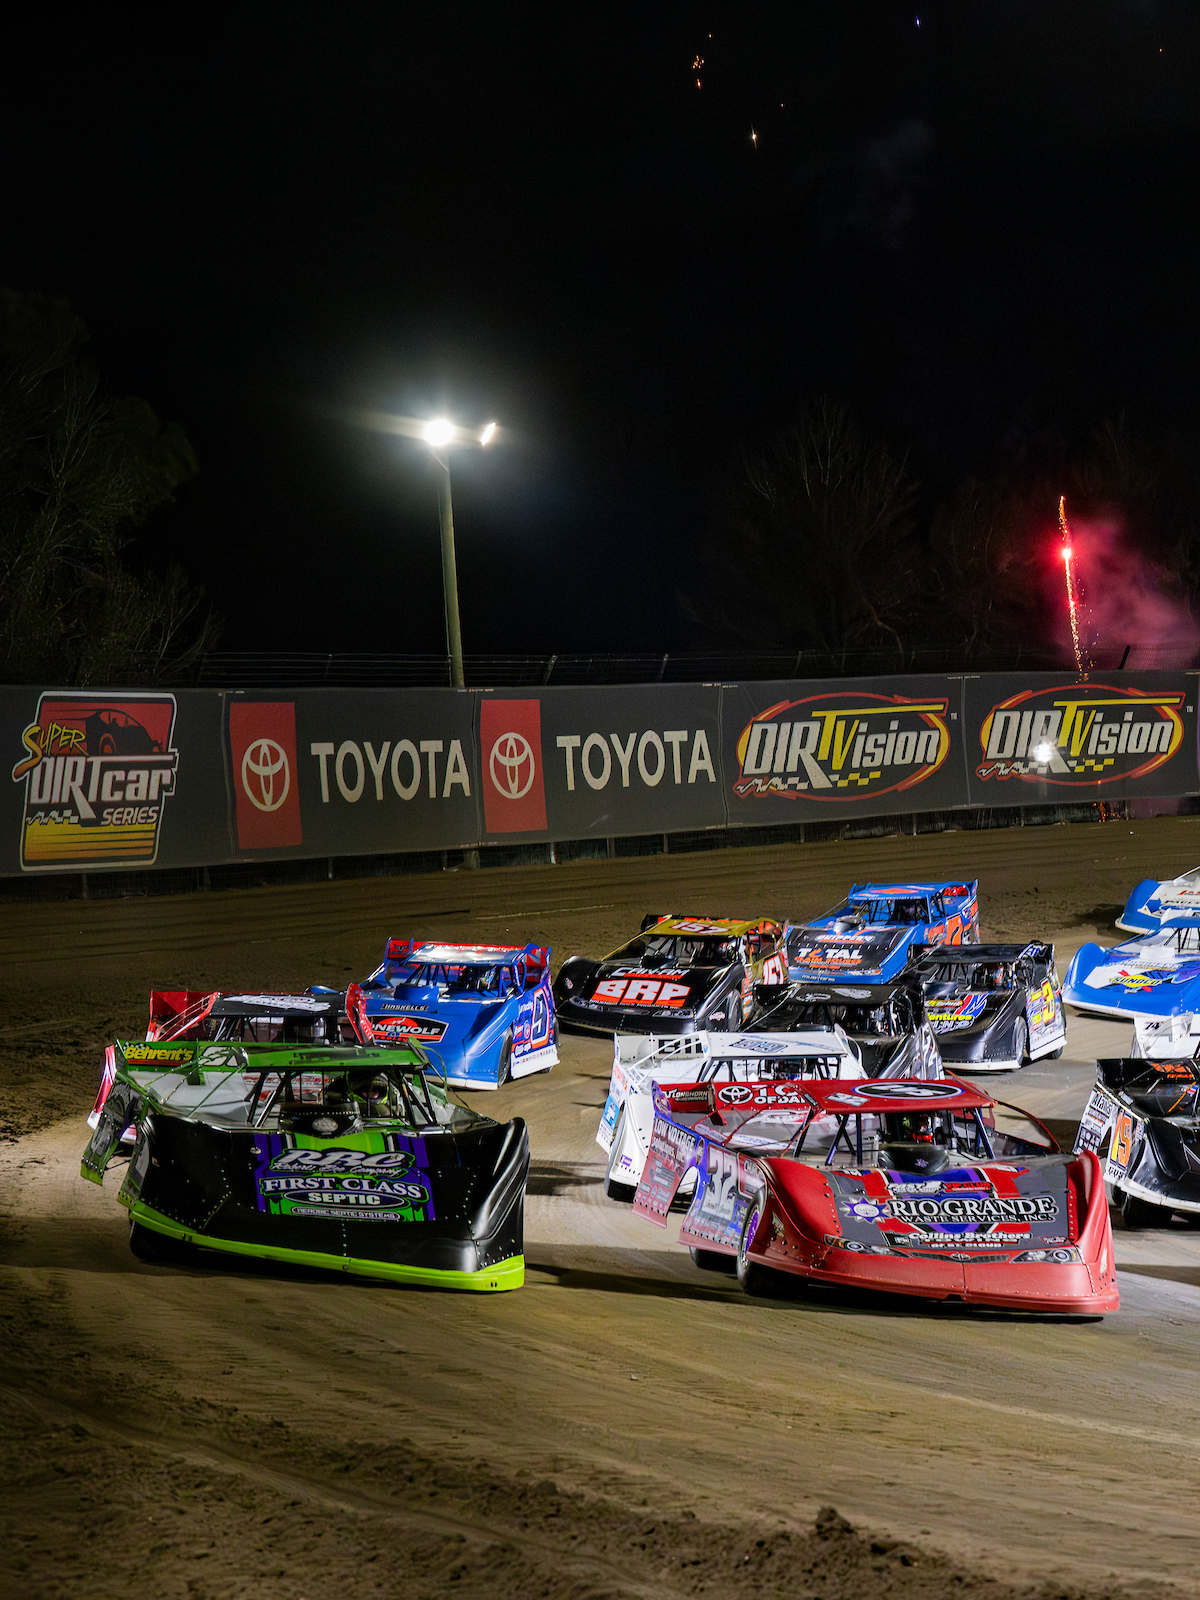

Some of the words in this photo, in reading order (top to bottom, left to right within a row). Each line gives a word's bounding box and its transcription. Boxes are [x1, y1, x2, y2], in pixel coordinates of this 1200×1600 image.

[14, 722, 90, 779] SUPER
[556, 730, 717, 791] TOYOTA
[311, 739, 471, 803] TOYOTA
[101, 806, 159, 826] SERIES
[372, 1024, 441, 1035] NEWOLF
[125, 1046, 195, 1061] Behrent's
[668, 1123, 697, 1150] VOLTAGE
[264, 1177, 336, 1191] FIRST
[341, 1178, 422, 1198] CLASS
[308, 1192, 381, 1205] SEPTIC
[889, 1200, 941, 1217] RIO
[943, 1197, 1055, 1216] GRANDE
[1024, 1214, 1051, 1222] INC.
